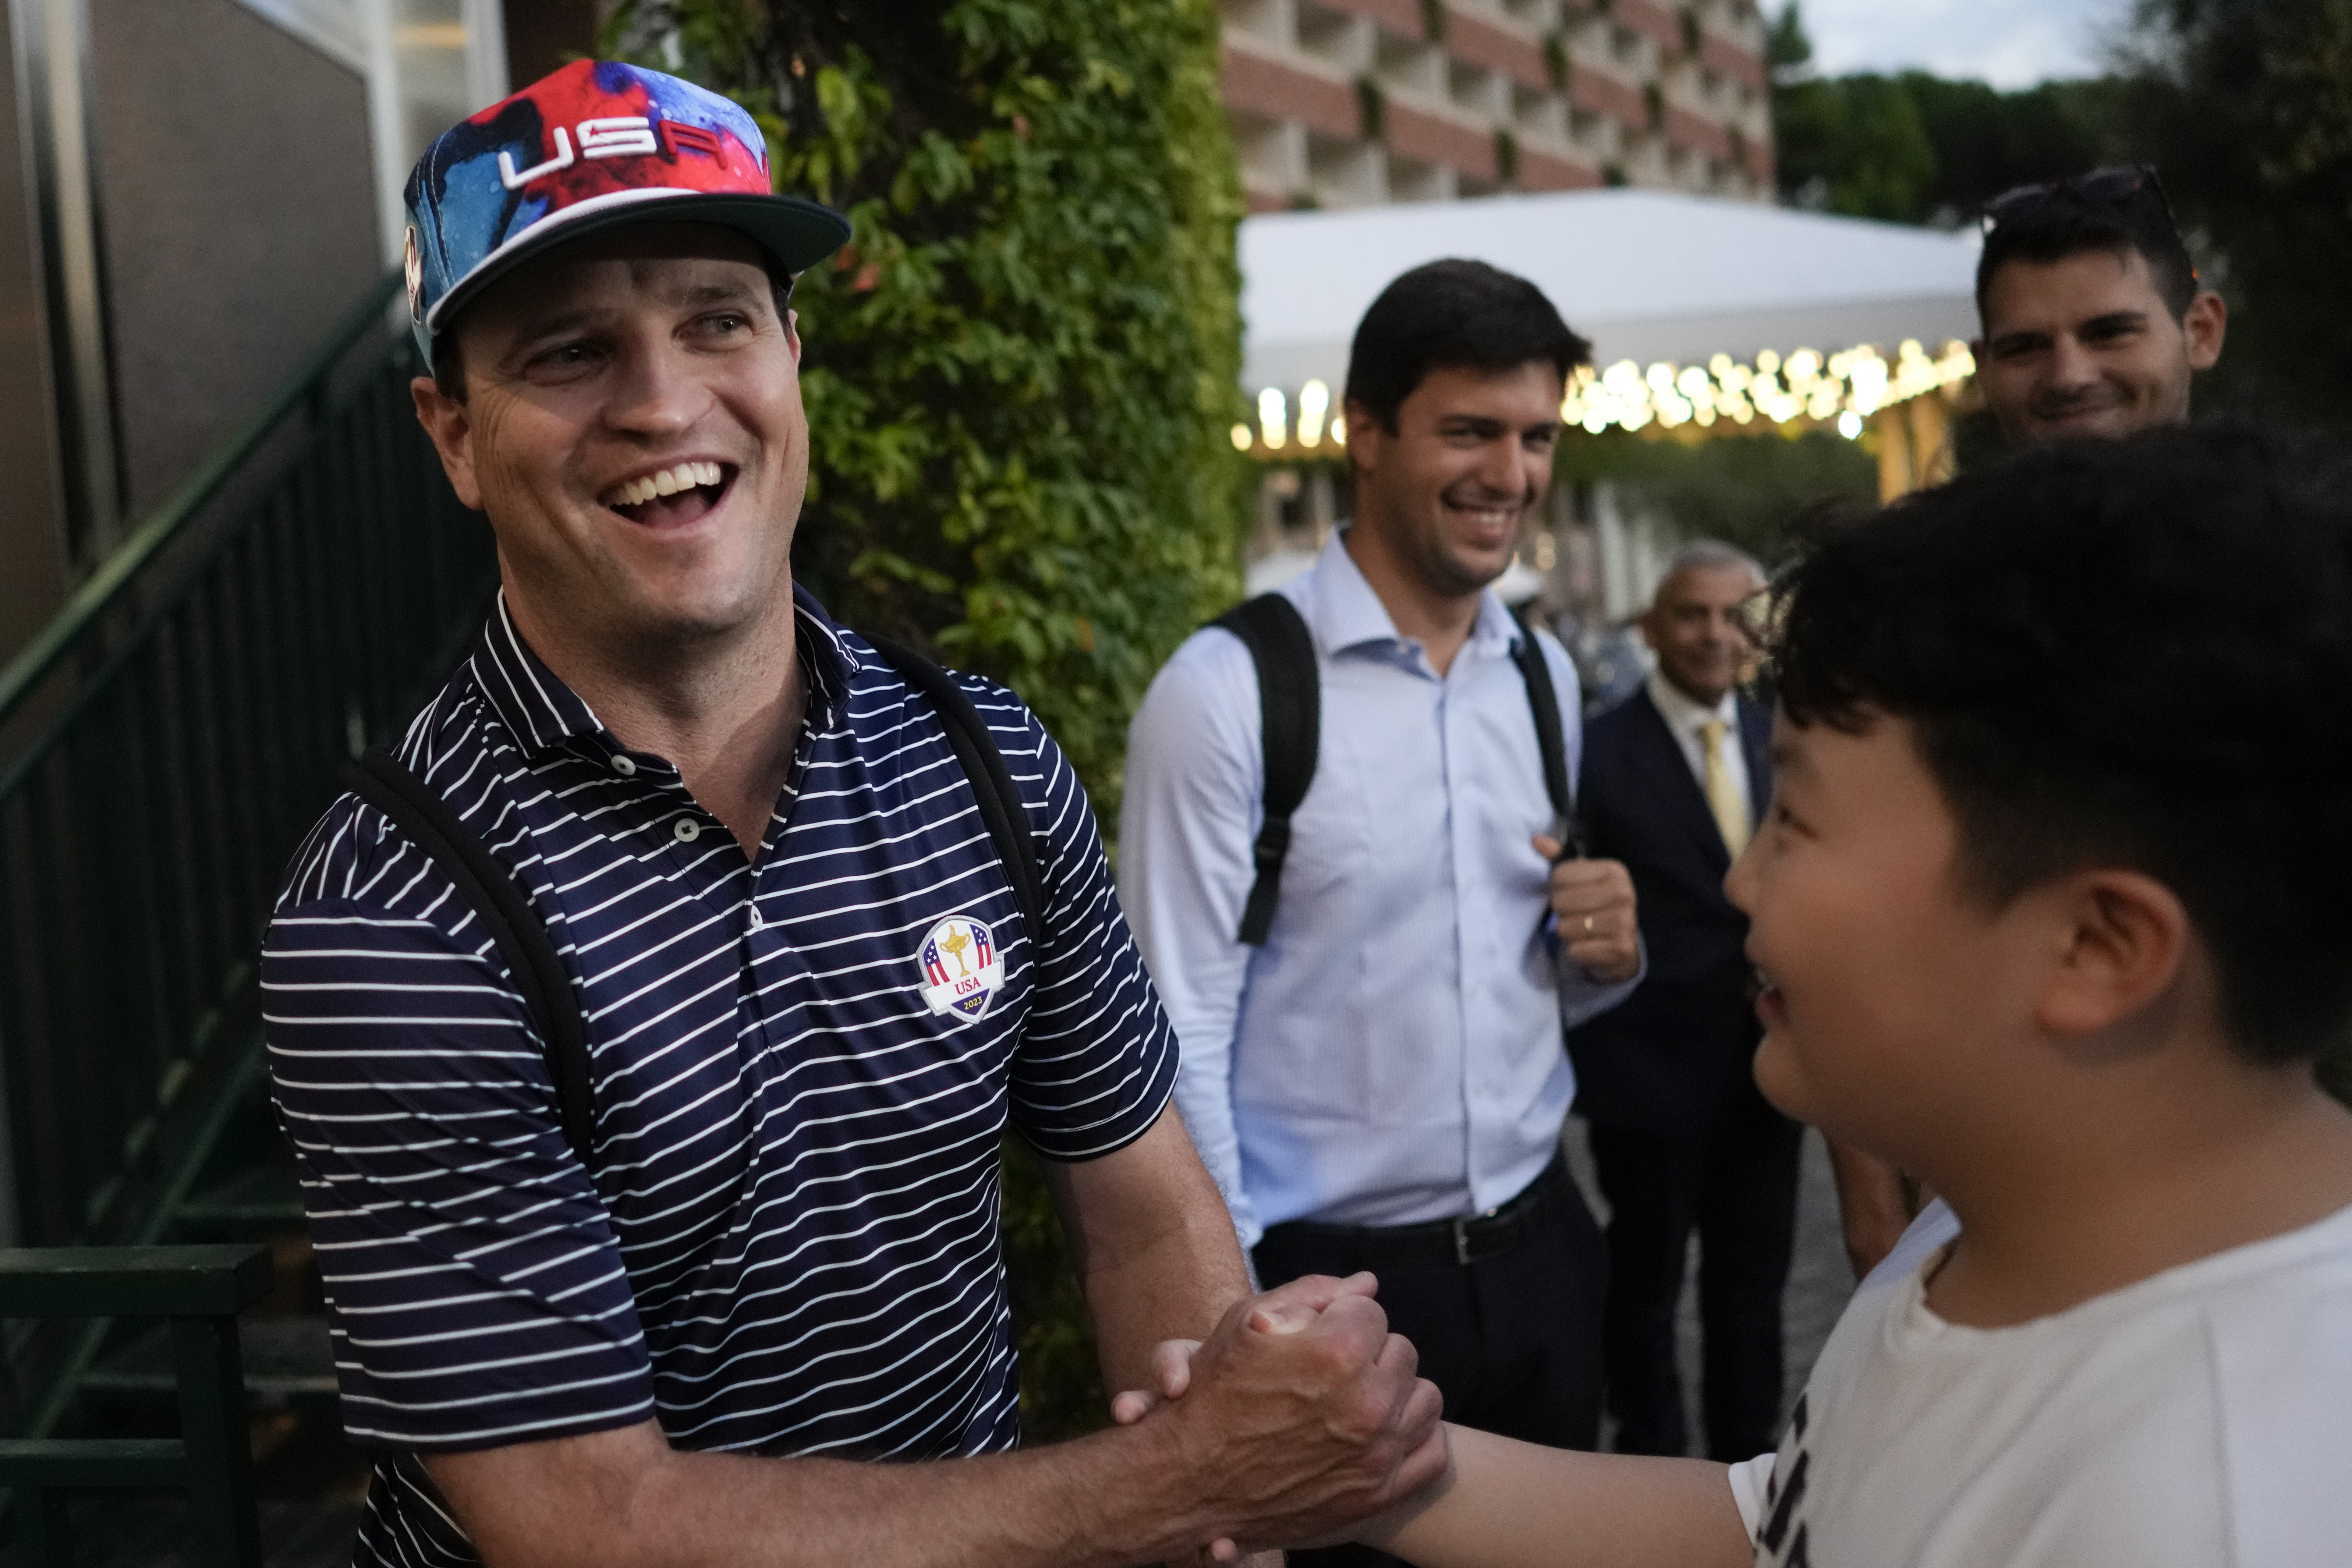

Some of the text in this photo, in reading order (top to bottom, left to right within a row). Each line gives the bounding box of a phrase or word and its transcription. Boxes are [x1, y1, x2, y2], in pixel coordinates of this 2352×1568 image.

[498, 116, 728, 189] USA
[954, 977, 981, 995] USA
[963, 996, 983, 1010] 2023
